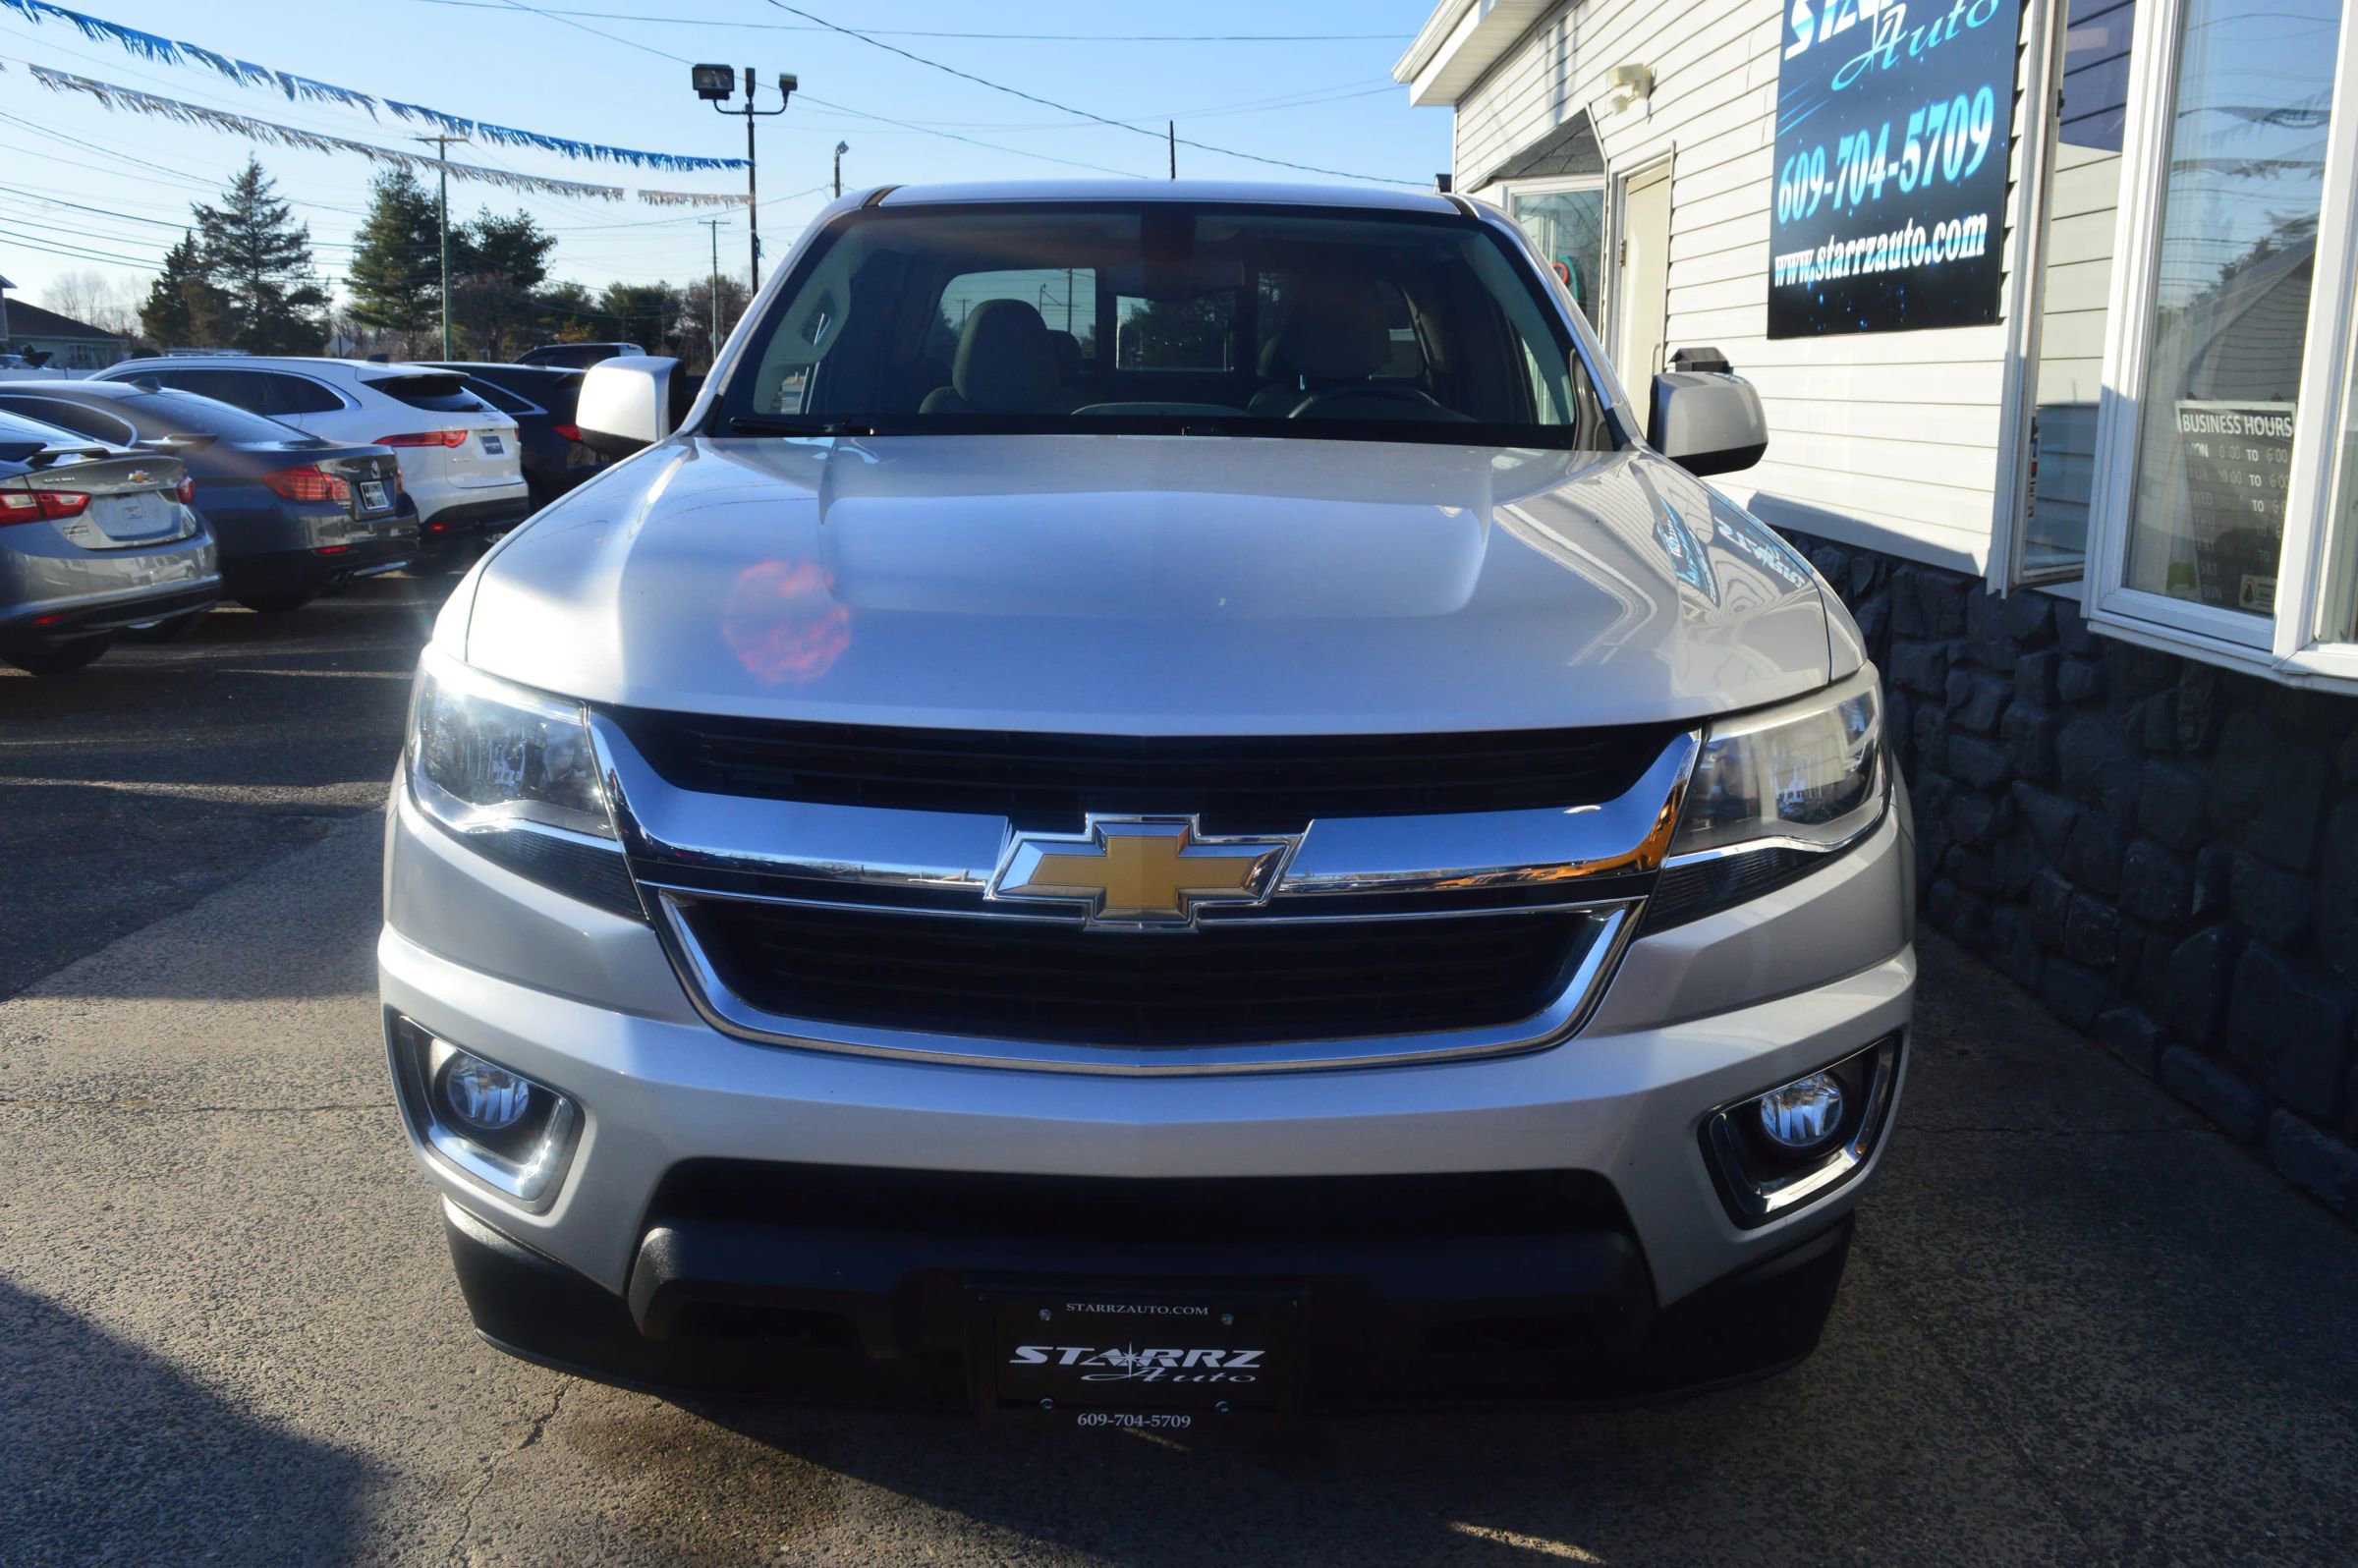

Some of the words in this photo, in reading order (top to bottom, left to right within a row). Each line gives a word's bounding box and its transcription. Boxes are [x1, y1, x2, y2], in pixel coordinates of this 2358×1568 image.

[1831, 0, 2000, 91] Auto
[1777, 84, 1995, 225] 609-704-5709
[1774, 213, 1989, 287] www.starrzauto.com
[2182, 413, 2242, 434] BUSINESS
[2244, 417, 2293, 438] HOURS
[2245, 448, 2259, 462] TO
[2248, 474, 2262, 487] TO
[2251, 499, 2265, 513] TO
[1066, 1303, 1208, 1316] STARRZAUTO.COM
[1009, 1345, 1265, 1369] STARRZ
[1081, 1367, 1257, 1382] Auto
[1077, 1413, 1191, 1428] 609-704-5709
